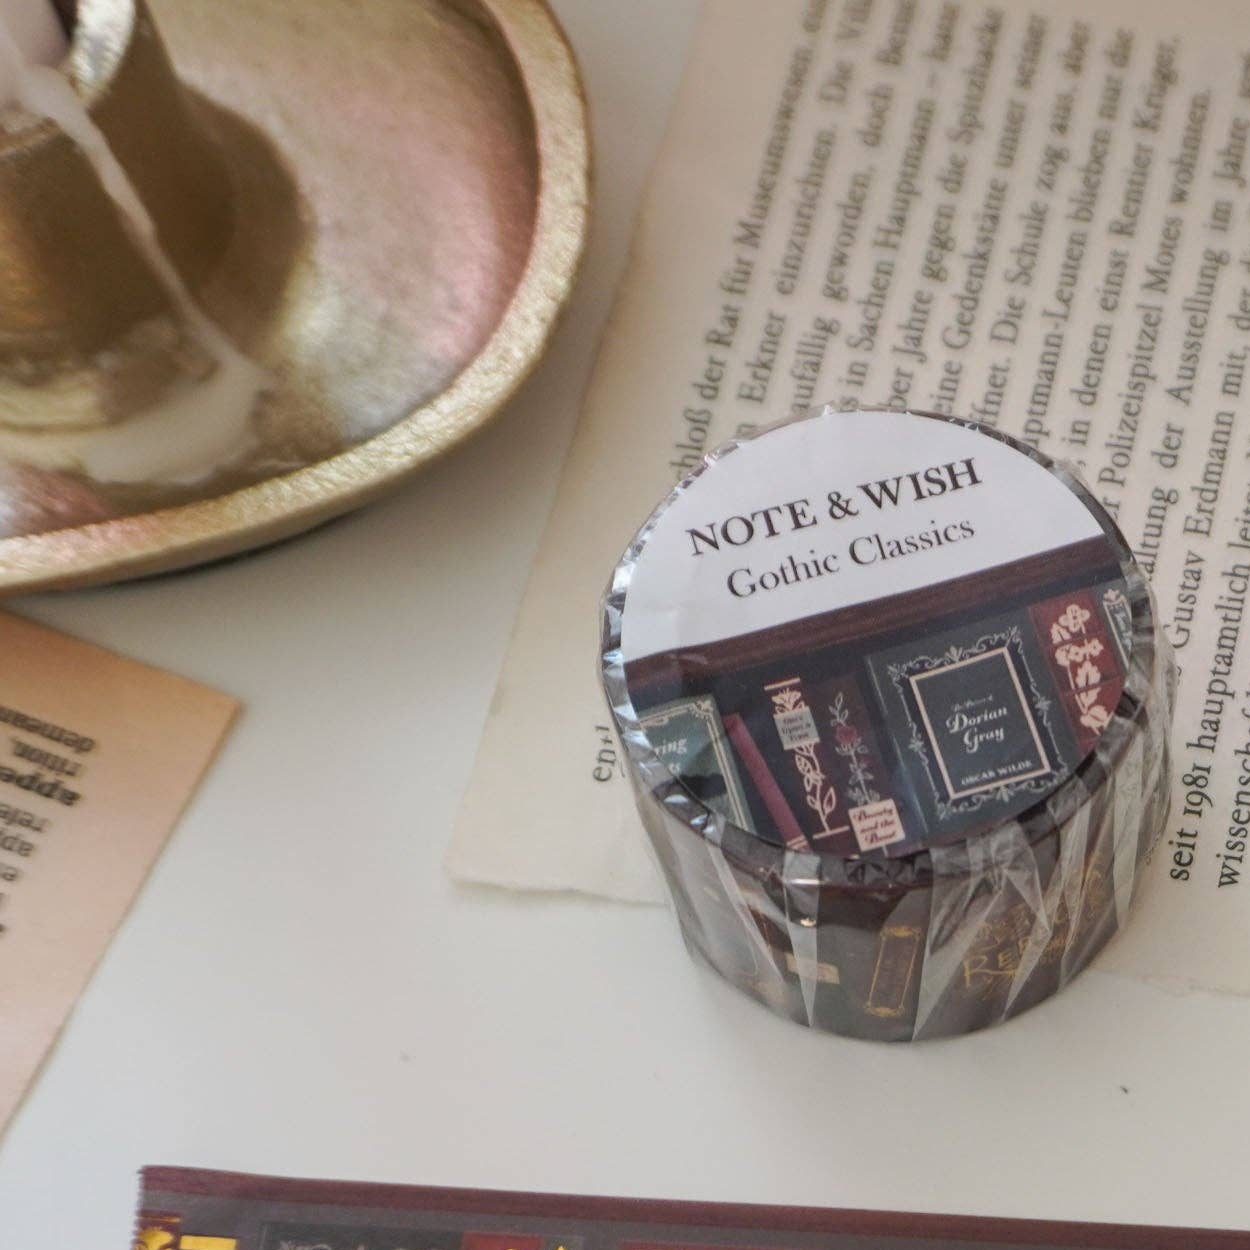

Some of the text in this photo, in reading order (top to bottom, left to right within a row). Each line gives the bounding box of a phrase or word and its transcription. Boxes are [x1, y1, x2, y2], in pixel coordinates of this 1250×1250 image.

[685, 457, 983, 556] NOTE & WISH
[726, 519, 975, 598] Gothic Classics
[945, 707, 1008, 734] Dorian
[963, 727, 1005, 754] Gray
[1181, 762, 1213, 818] 1981
[1167, 827, 1198, 881] seit
